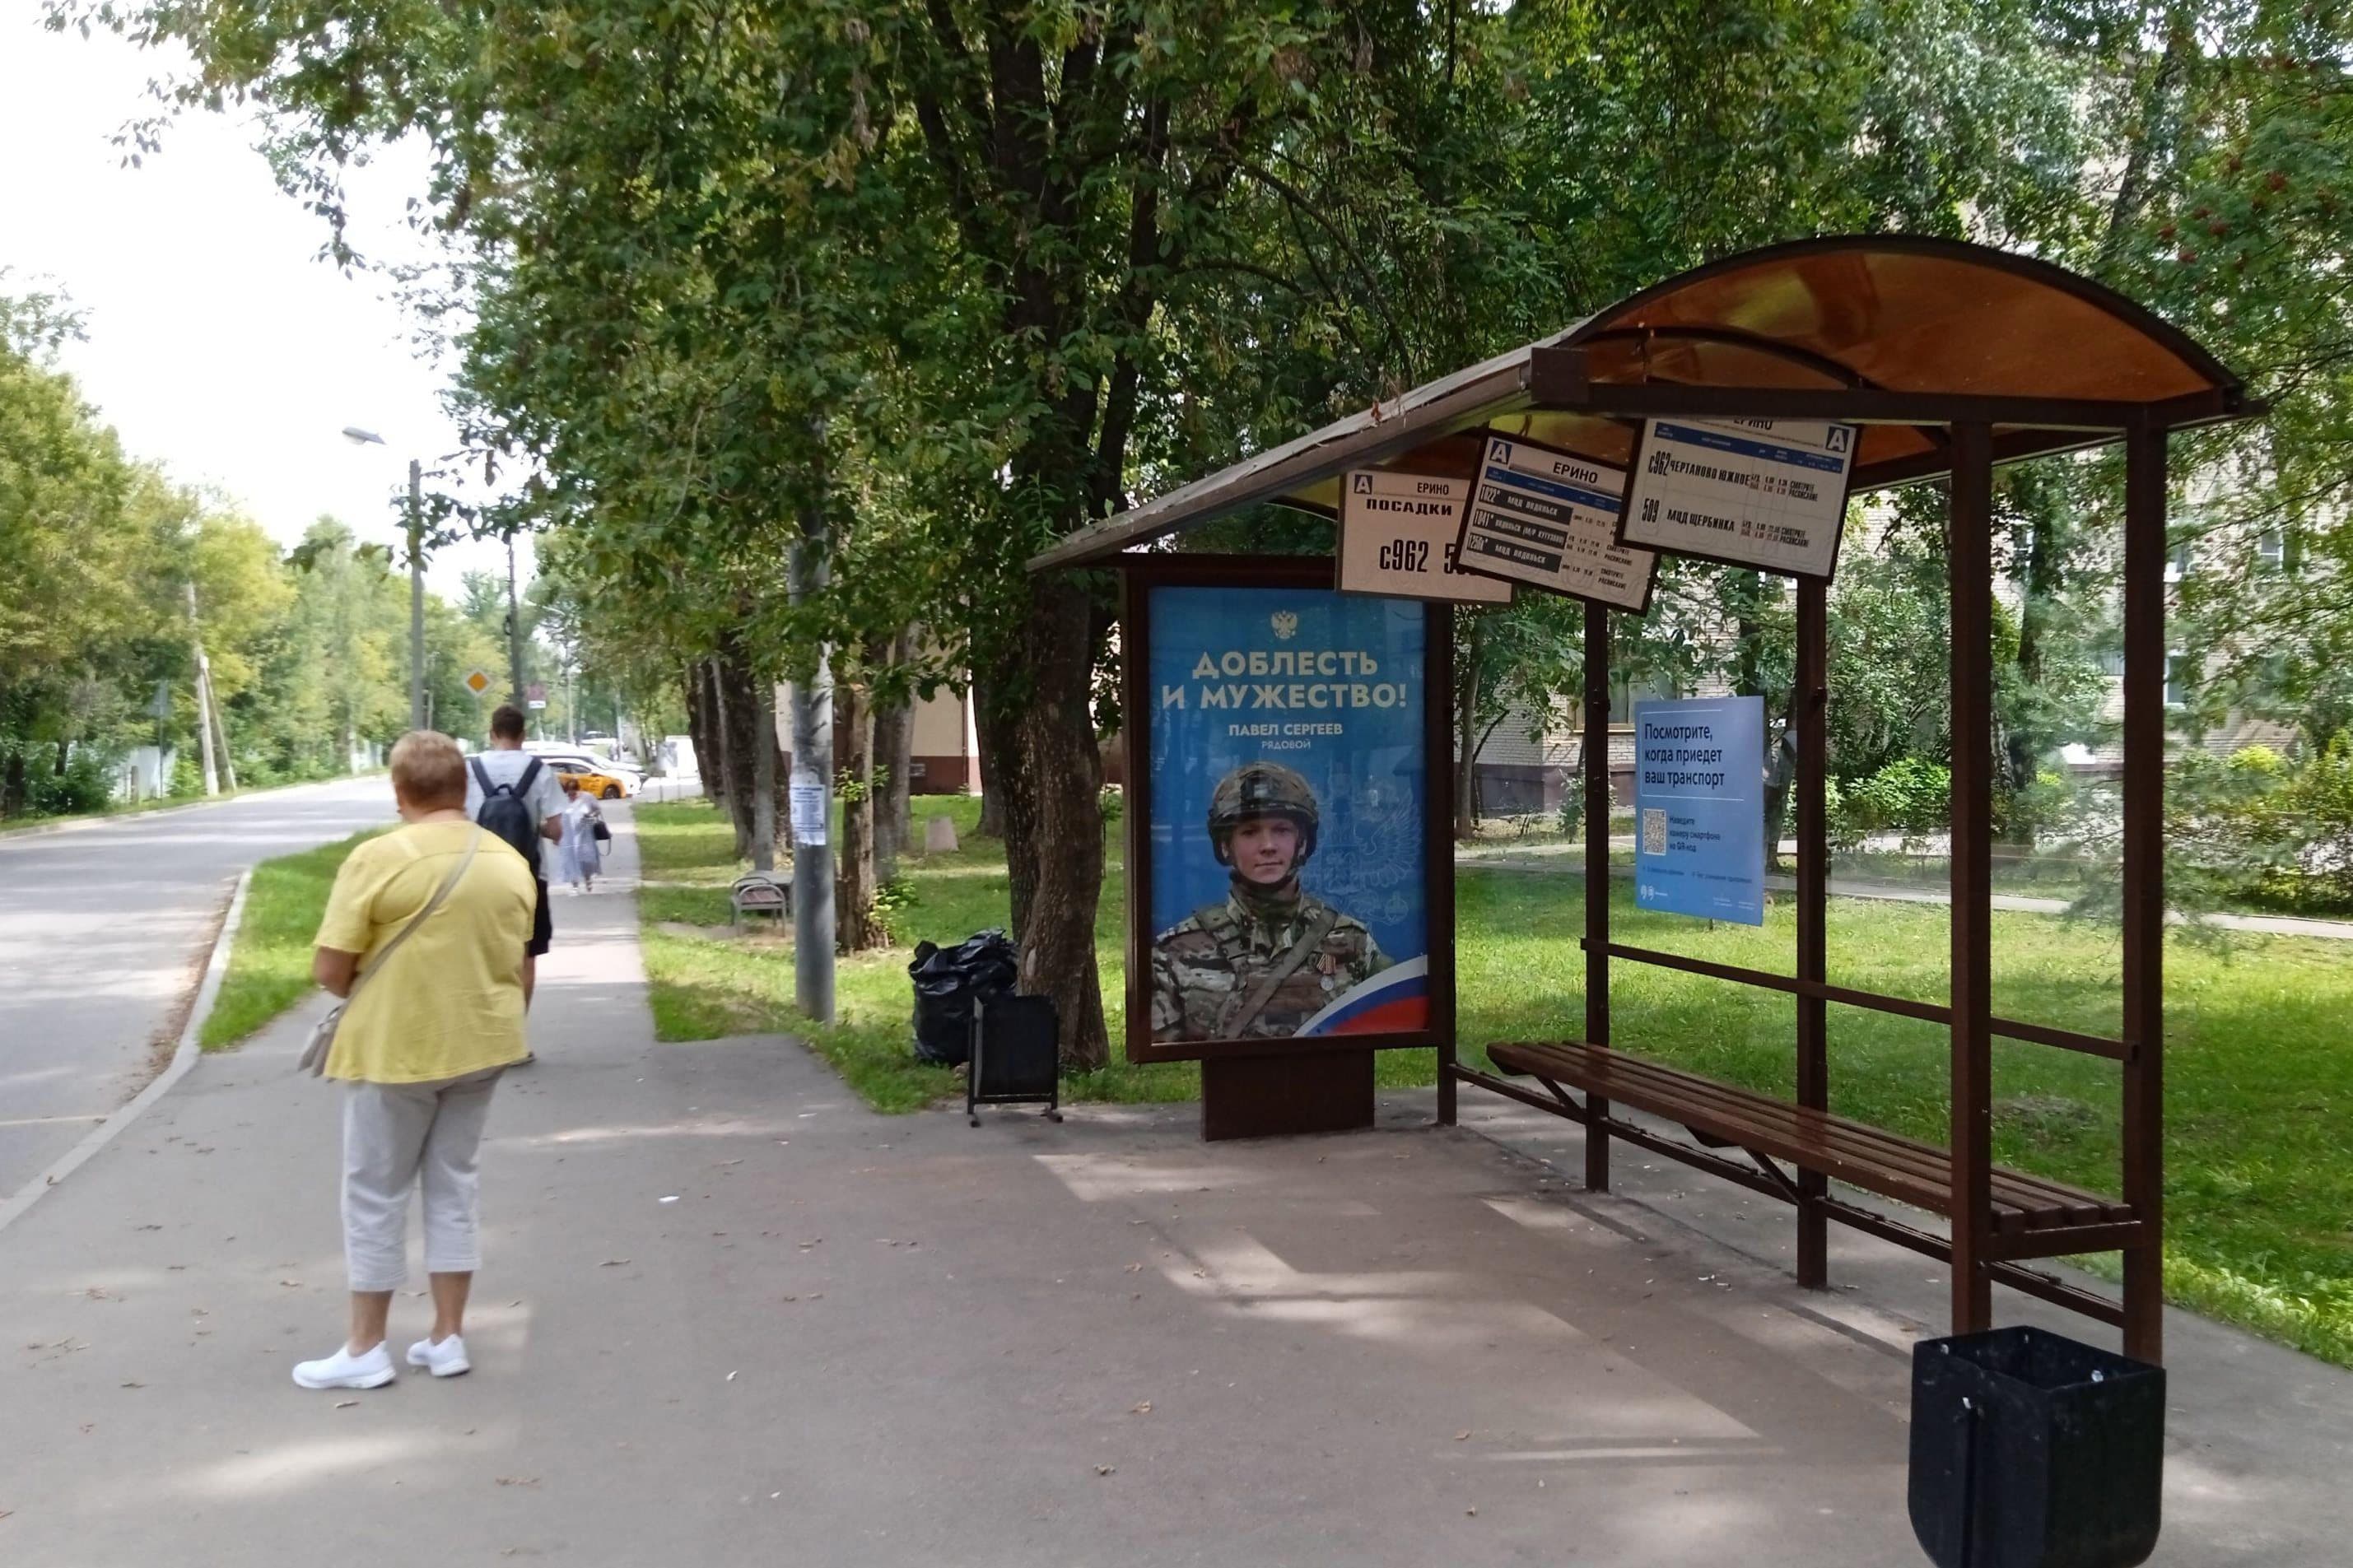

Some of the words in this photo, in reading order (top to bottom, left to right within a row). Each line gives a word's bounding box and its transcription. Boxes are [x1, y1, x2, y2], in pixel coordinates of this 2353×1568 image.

[1733, 418, 1773, 430] ИНО
[1553, 461, 1598, 484] ЕРИНО
[1648, 450, 1670, 476] с962
[1670, 460, 1717, 479] ЧЕРТАНОВО
[1718, 469, 1750, 486] ЮЖНОЕ
[1417, 482, 1450, 495] ЕРИНО
[1366, 498, 1452, 515] ПОСАДКИ
[1642, 498, 1660, 523] 509
[1666, 509, 1689, 524] МЦД
[1689, 513, 1735, 532] ЩЕРБИНКА
[1379, 538, 1429, 573] с962
[1192, 651, 1378, 680] ДОБЛЕСТЬ
[1162, 685, 1185, 710] И
[1200, 683, 1407, 710] МУЖЕСТВО!
[1229, 724, 1278, 737] ПАВЕЛ
[1284, 723, 1344, 737] СЕРГЕЕВ
[1645, 723, 1712, 742] Посмотрите,
[1261, 739, 1312, 751] РЯДОВОЙ
[1645, 749, 1673, 764] когда
[1676, 750, 1722, 765] приедет
[1645, 771, 1665, 784] ваш
[1667, 772, 1725, 790] транспорт
